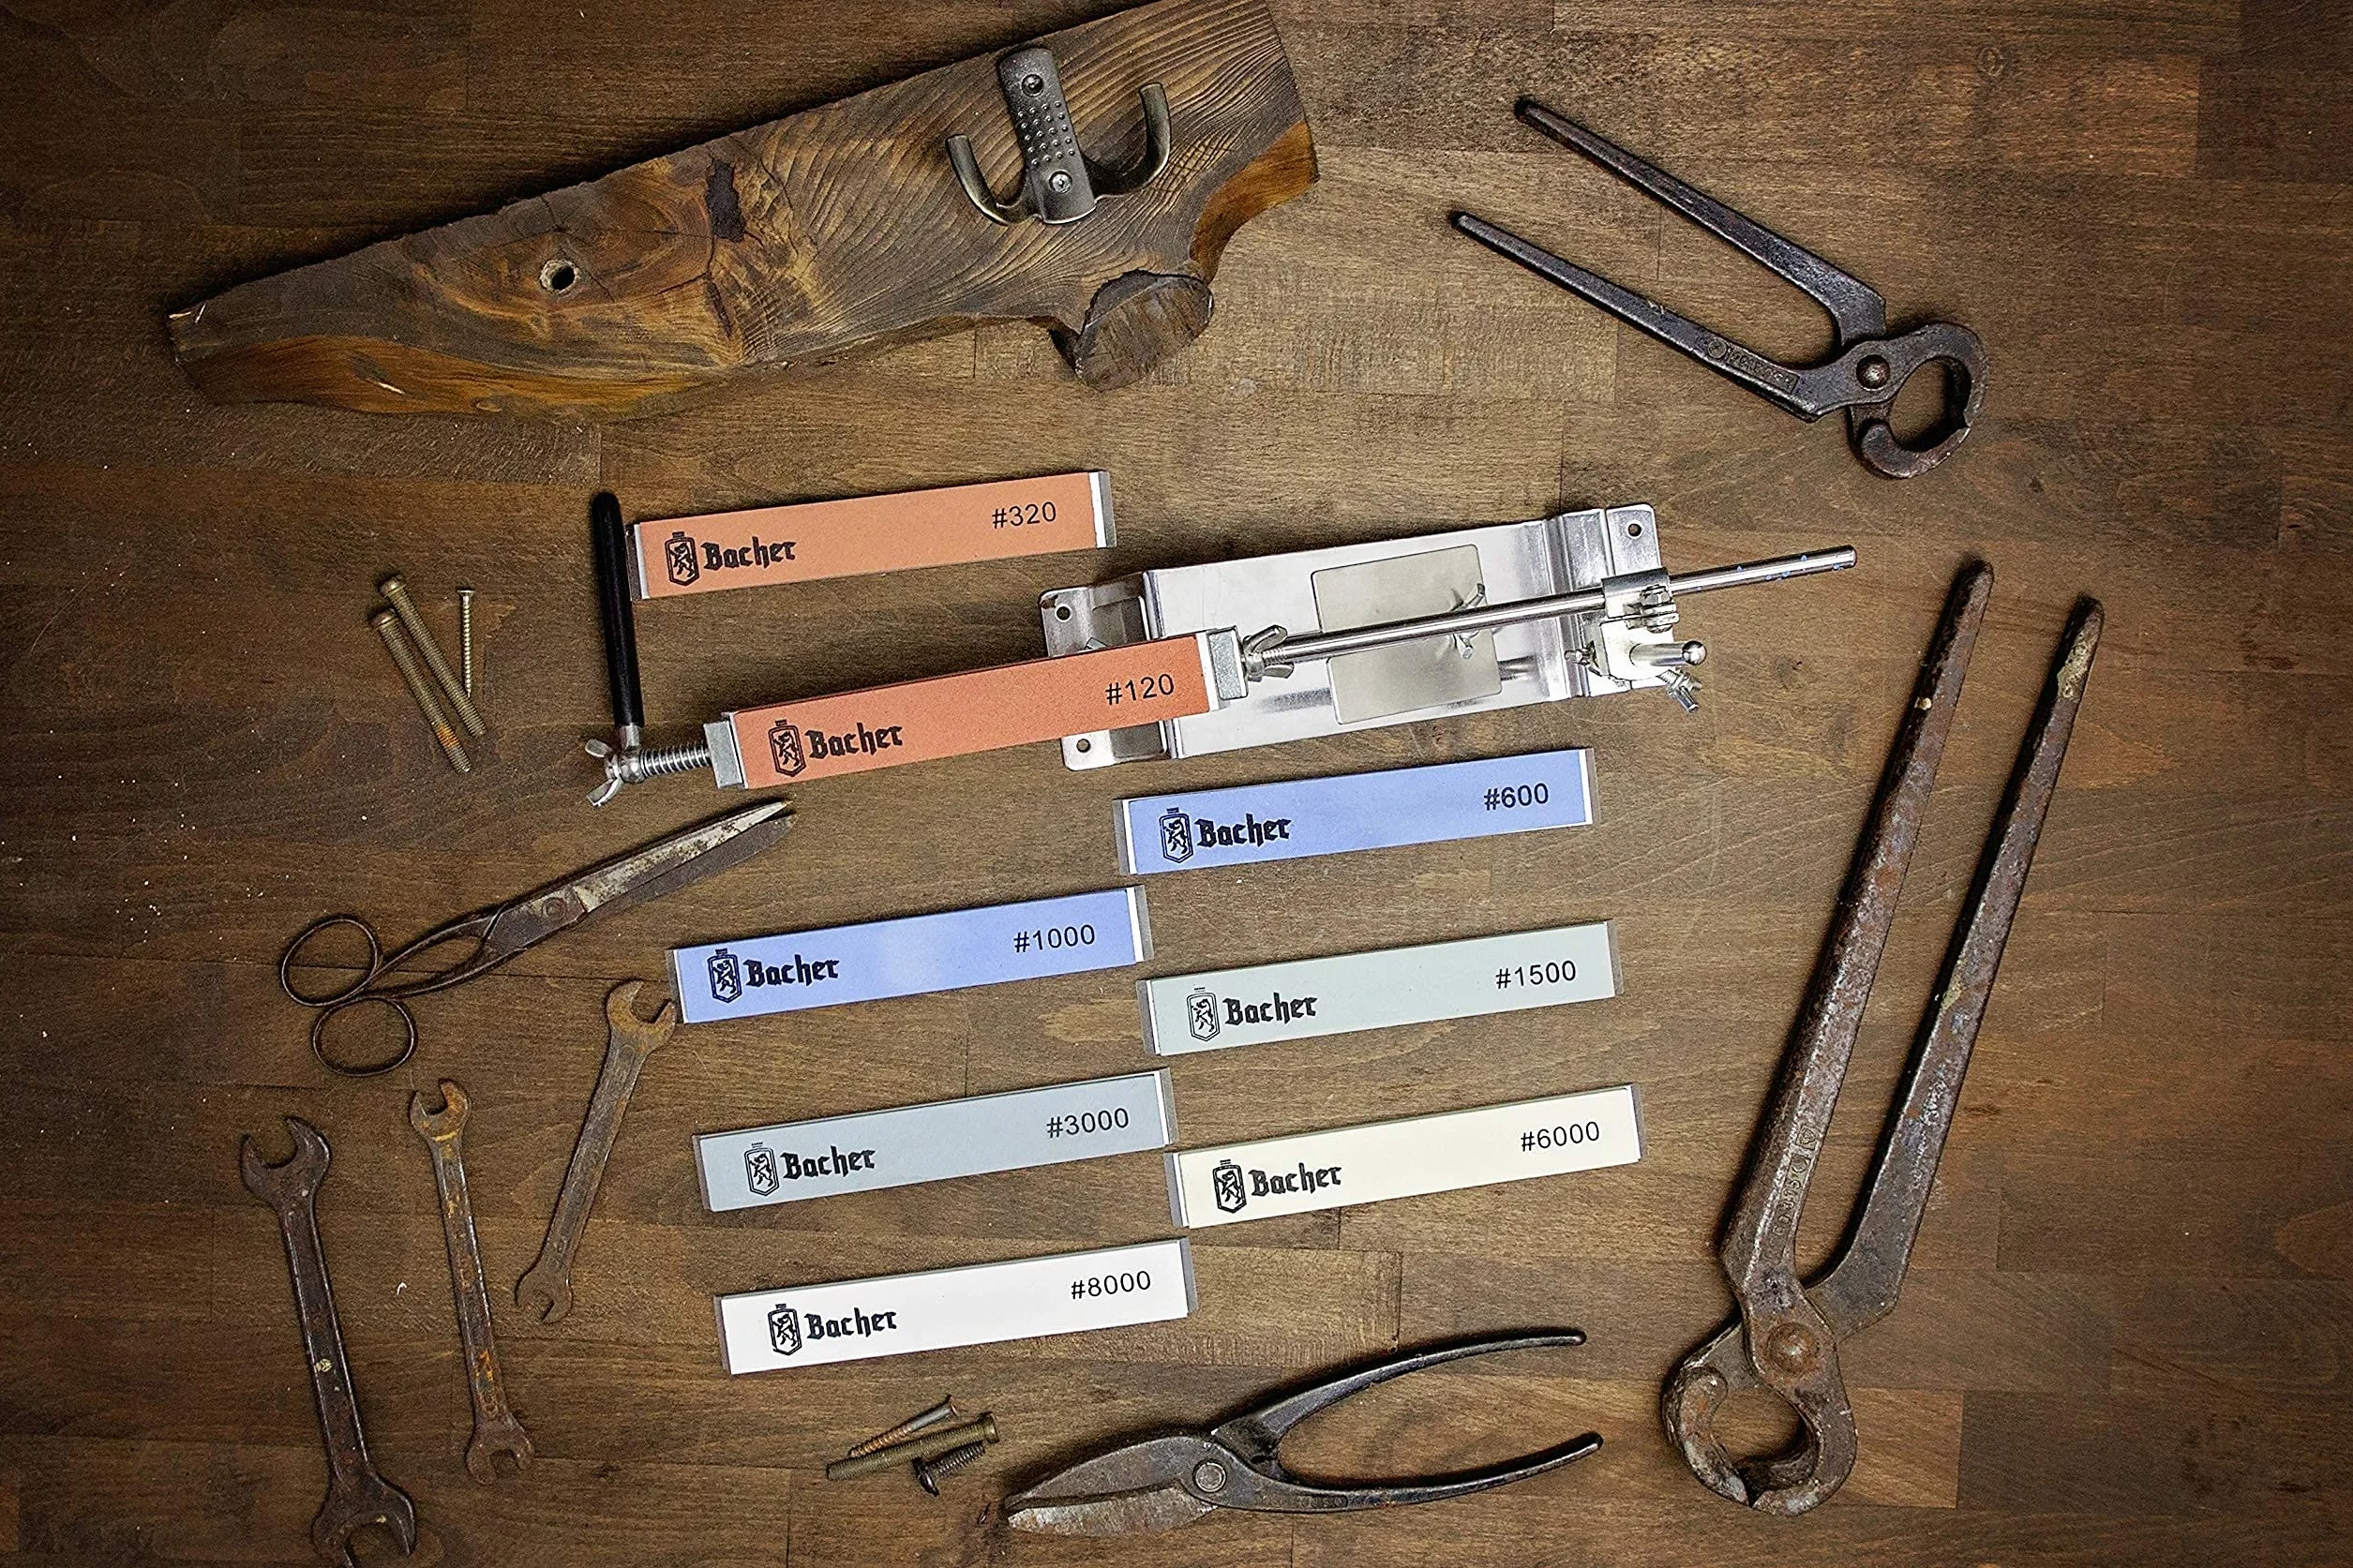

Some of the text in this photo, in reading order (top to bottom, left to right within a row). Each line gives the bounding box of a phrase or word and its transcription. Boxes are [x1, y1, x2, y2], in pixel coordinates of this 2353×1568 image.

[991, 501, 1057, 530] #320
[699, 535, 797, 572] Bacher
[1104, 673, 1175, 706] #120
[803, 722, 903, 760] Bacher
[1483, 783, 1549, 812] #600
[1193, 813, 1292, 848] Bacher
[1012, 924, 1095, 953] #1000
[742, 953, 840, 988] Bacher
[1495, 960, 1577, 990] #1500
[1221, 992, 1318, 1026] Bacher
[1045, 1107, 1129, 1139] #3000
[1520, 1121, 1600, 1153] #6000
[779, 1145, 877, 1180] Bacher
[1248, 1162, 1342, 1198] Bacher
[1071, 1270, 1151, 1300] #8000
[803, 1307, 897, 1340] Bacher
